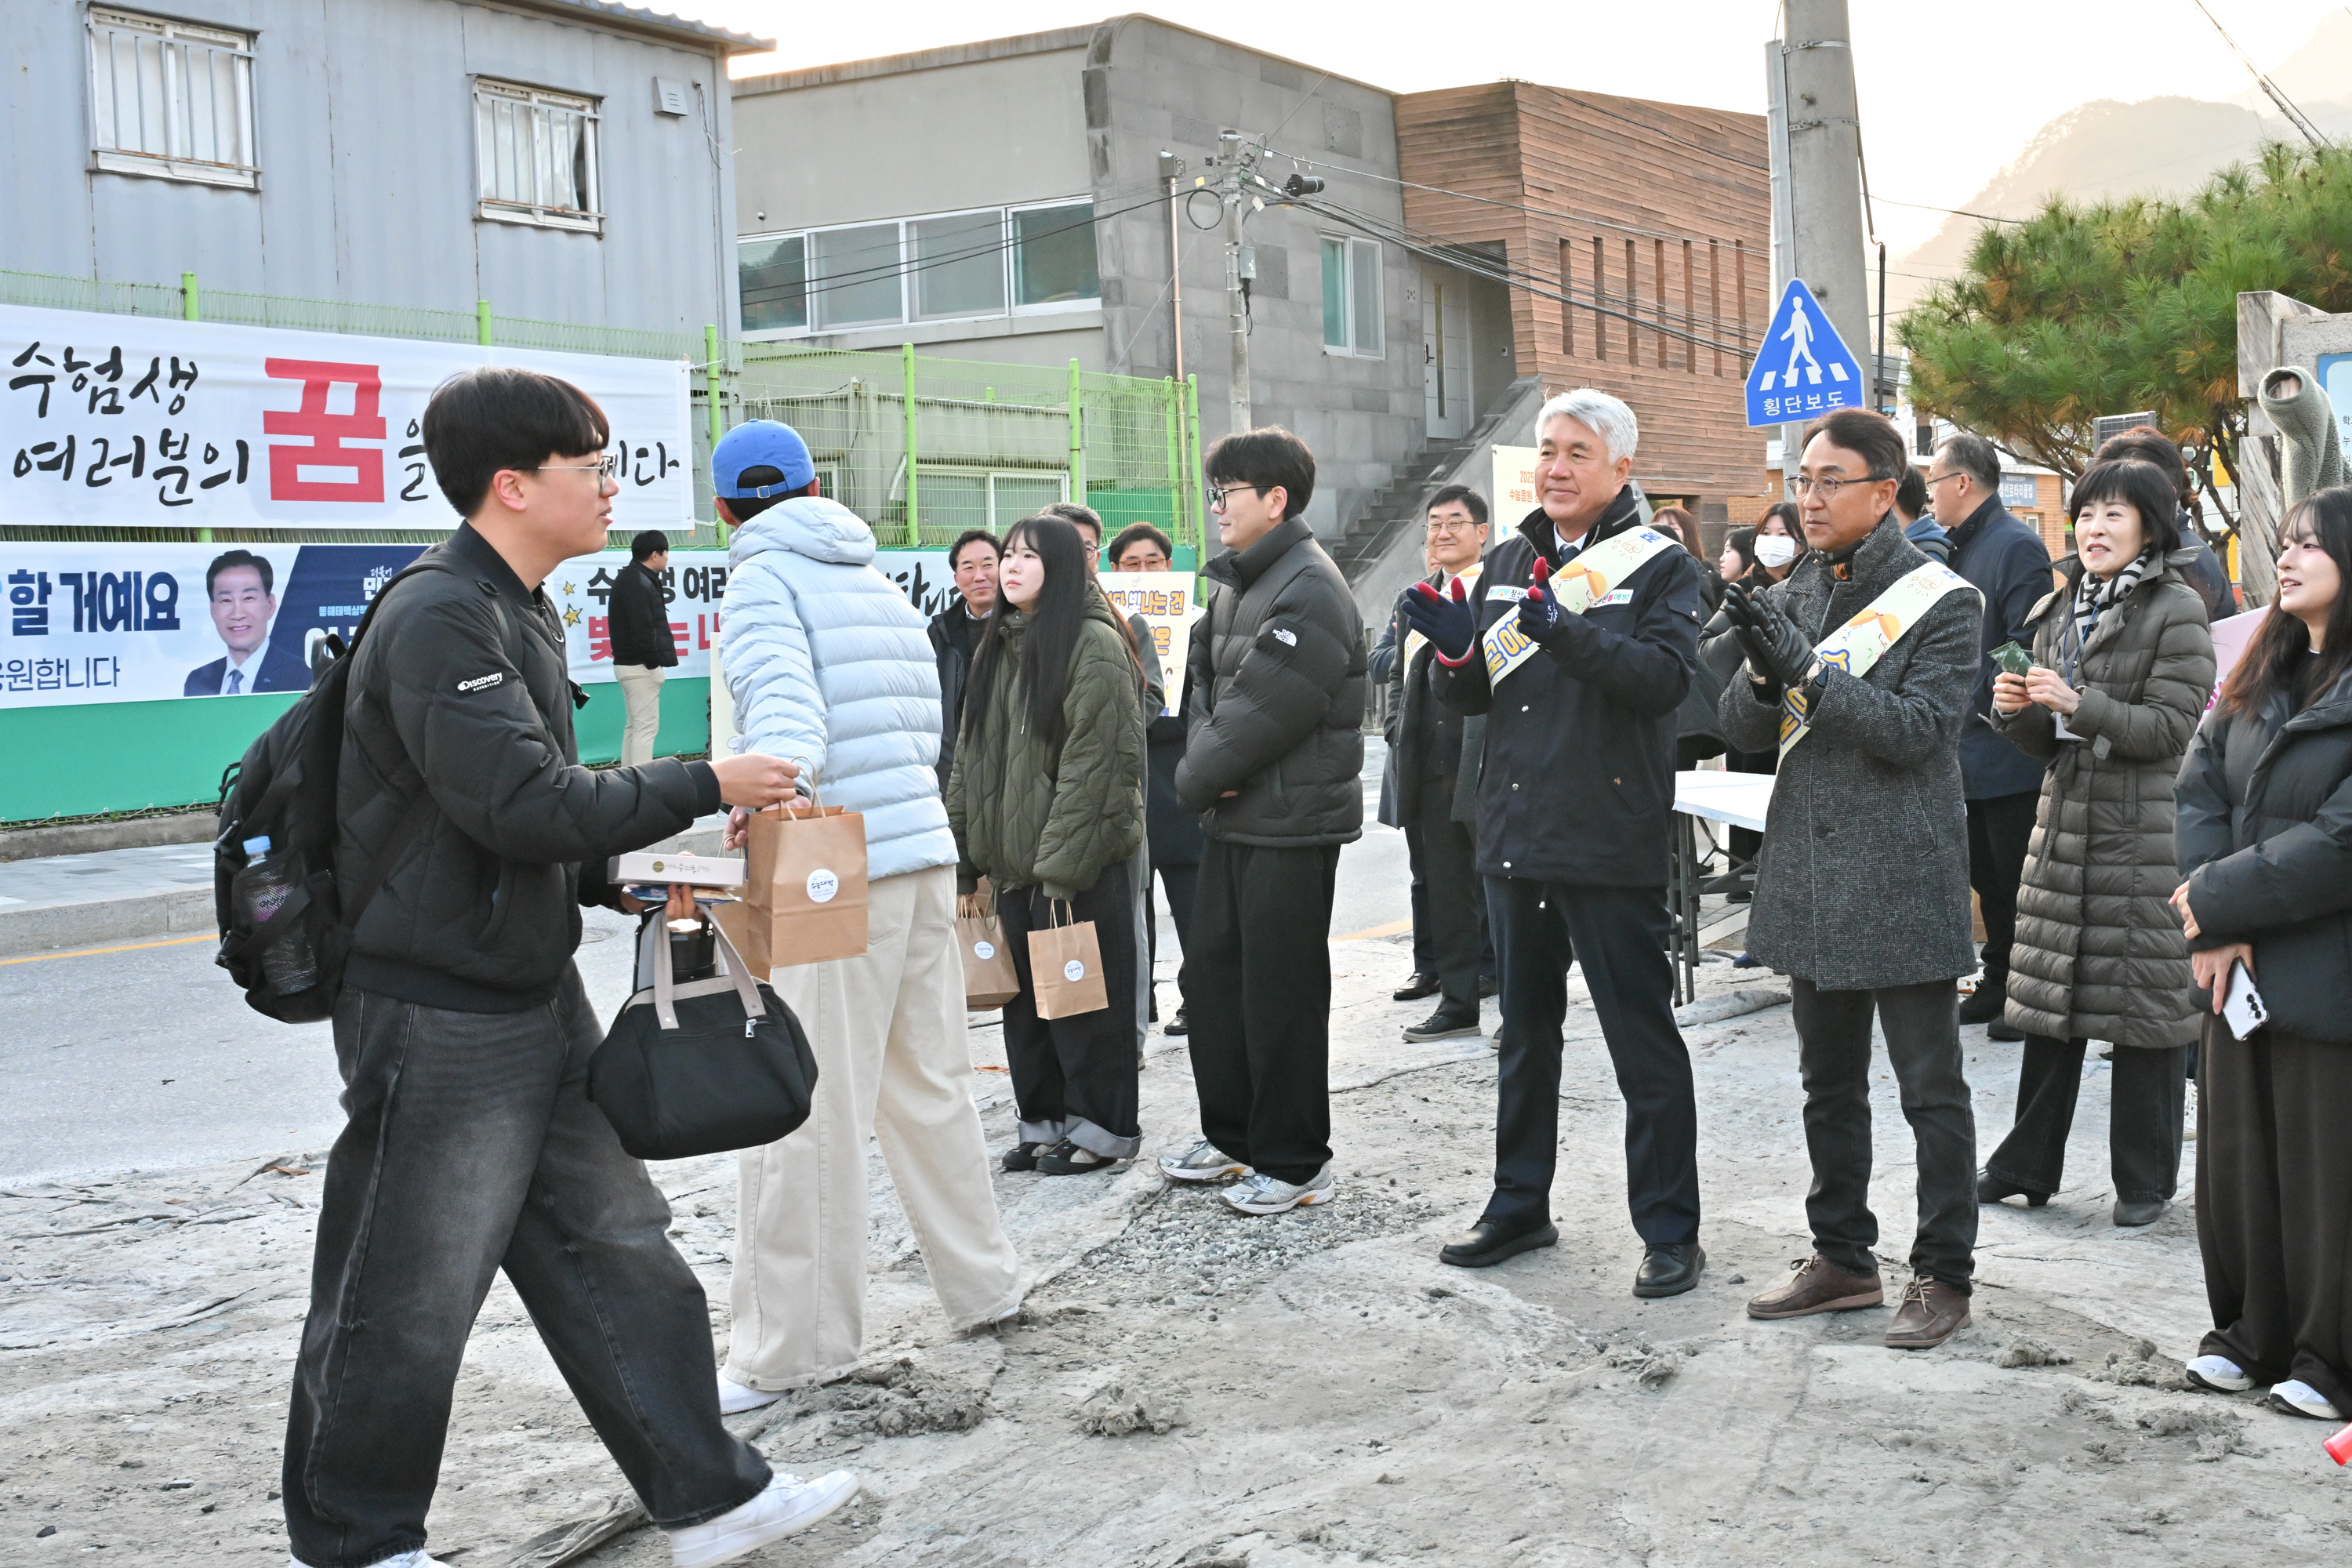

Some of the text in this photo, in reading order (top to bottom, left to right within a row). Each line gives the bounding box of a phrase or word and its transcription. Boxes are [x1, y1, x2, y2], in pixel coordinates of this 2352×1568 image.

[9, 341, 198, 418] 수험생
[1763, 390, 1845, 416] 횡단보도
[13, 428, 249, 506] 여러분의
[263, 358, 429, 503] 꿈을
[1509, 488, 1533, 503] 수능응원
[370, 565, 393, 578] 더불어
[586, 567, 676, 605] 수생
[8, 569, 180, 636] 할 거예요
[1128, 590, 1167, 615] 빛나는
[1170, 590, 1185, 615] 건
[0, 655, 121, 691] 원합니다
[811, 880, 834, 890] 수능대박
